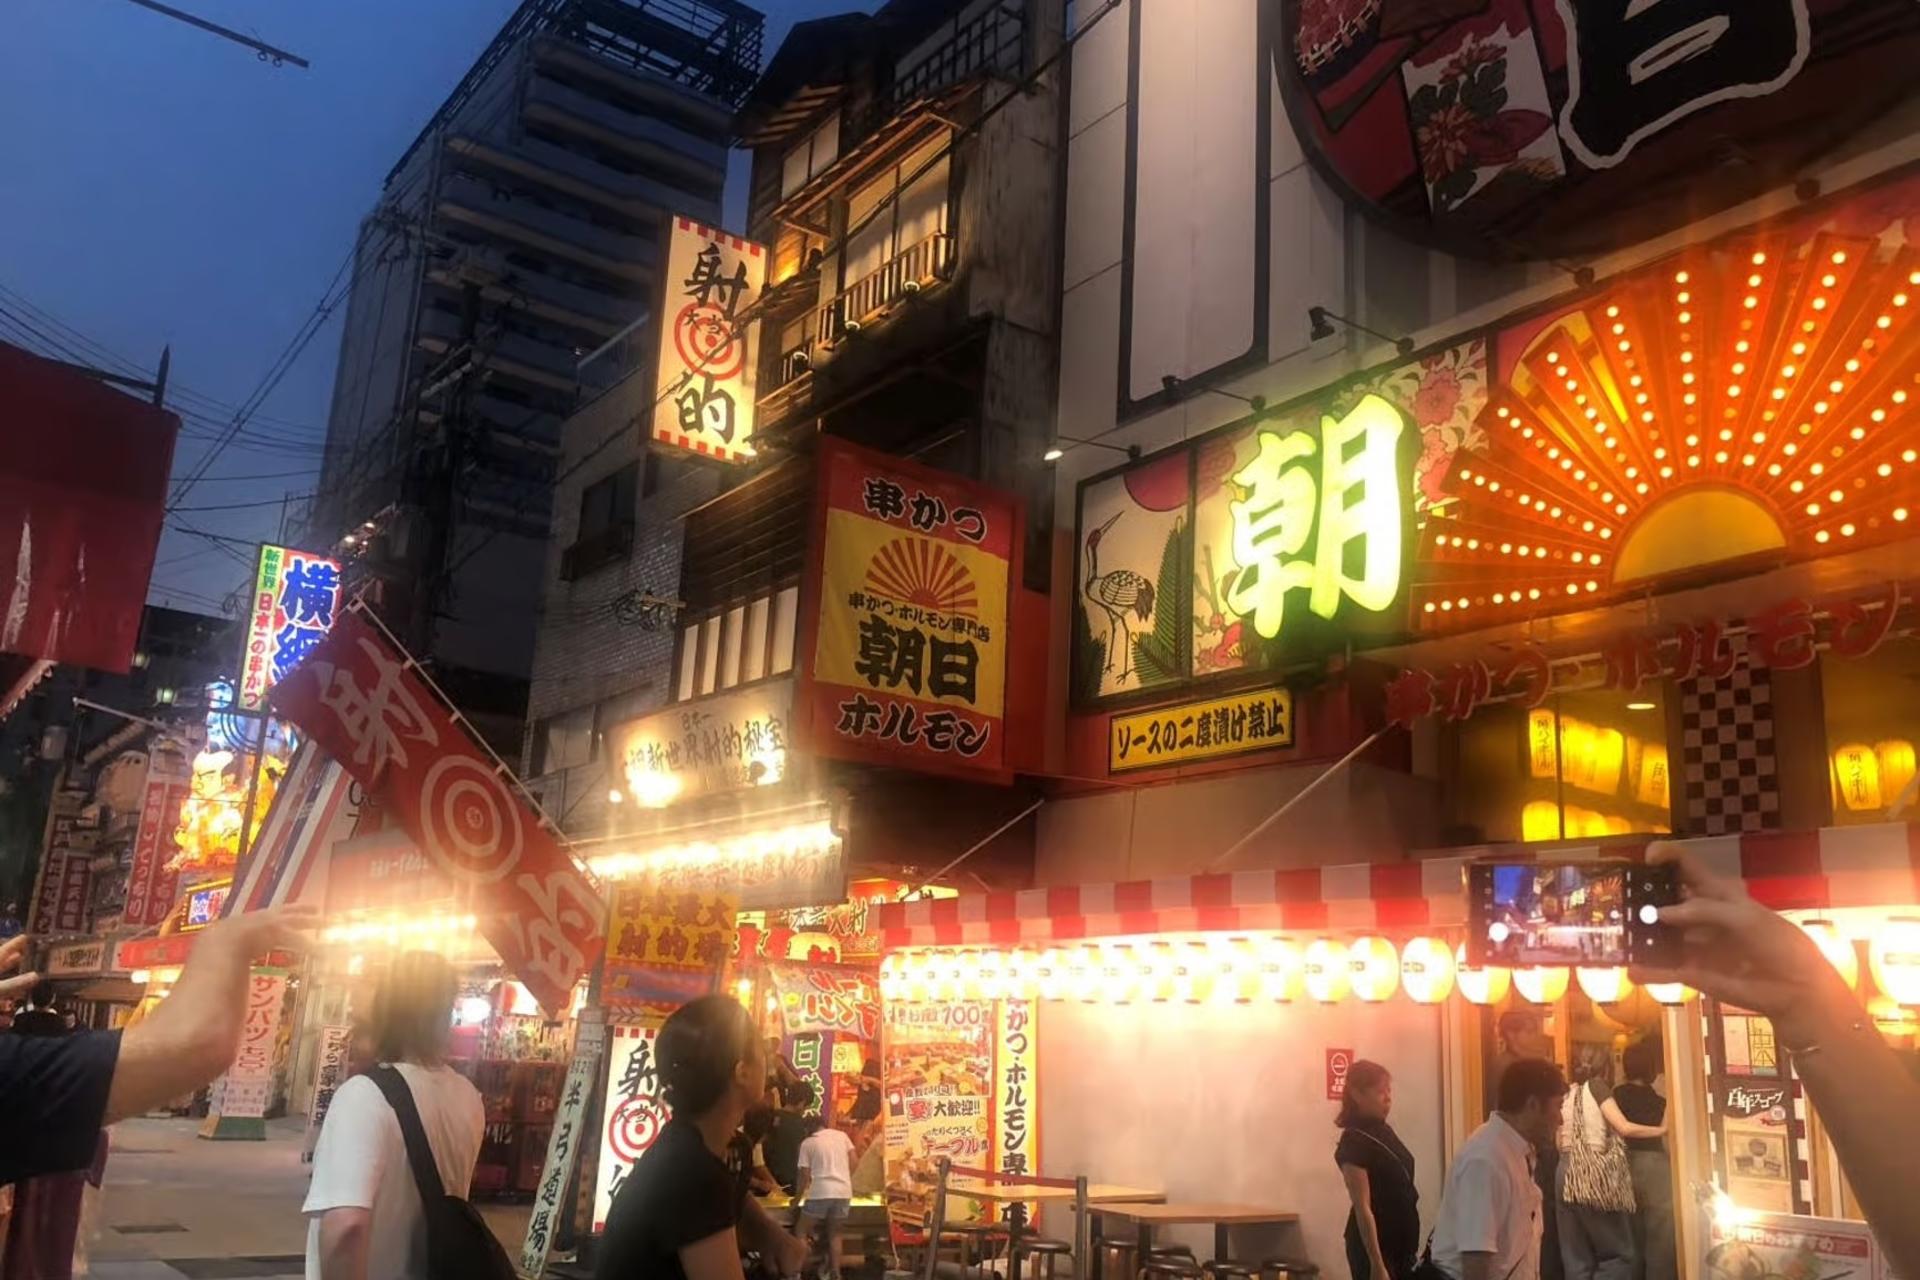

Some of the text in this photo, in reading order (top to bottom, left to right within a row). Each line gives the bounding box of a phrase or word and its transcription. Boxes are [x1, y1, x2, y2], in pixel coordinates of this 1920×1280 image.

[674, 242, 749, 445] 射的
[864, 477, 988, 543] 串かつ
[1227, 394, 1404, 639] 朝
[854, 613, 979, 706] 朝日
[840, 693, 991, 757] ホルモン
[1117, 697, 1286, 761] ソースの二度漬け禁止
[1000, 998, 1029, 1226] かつ・ホルモン専店
